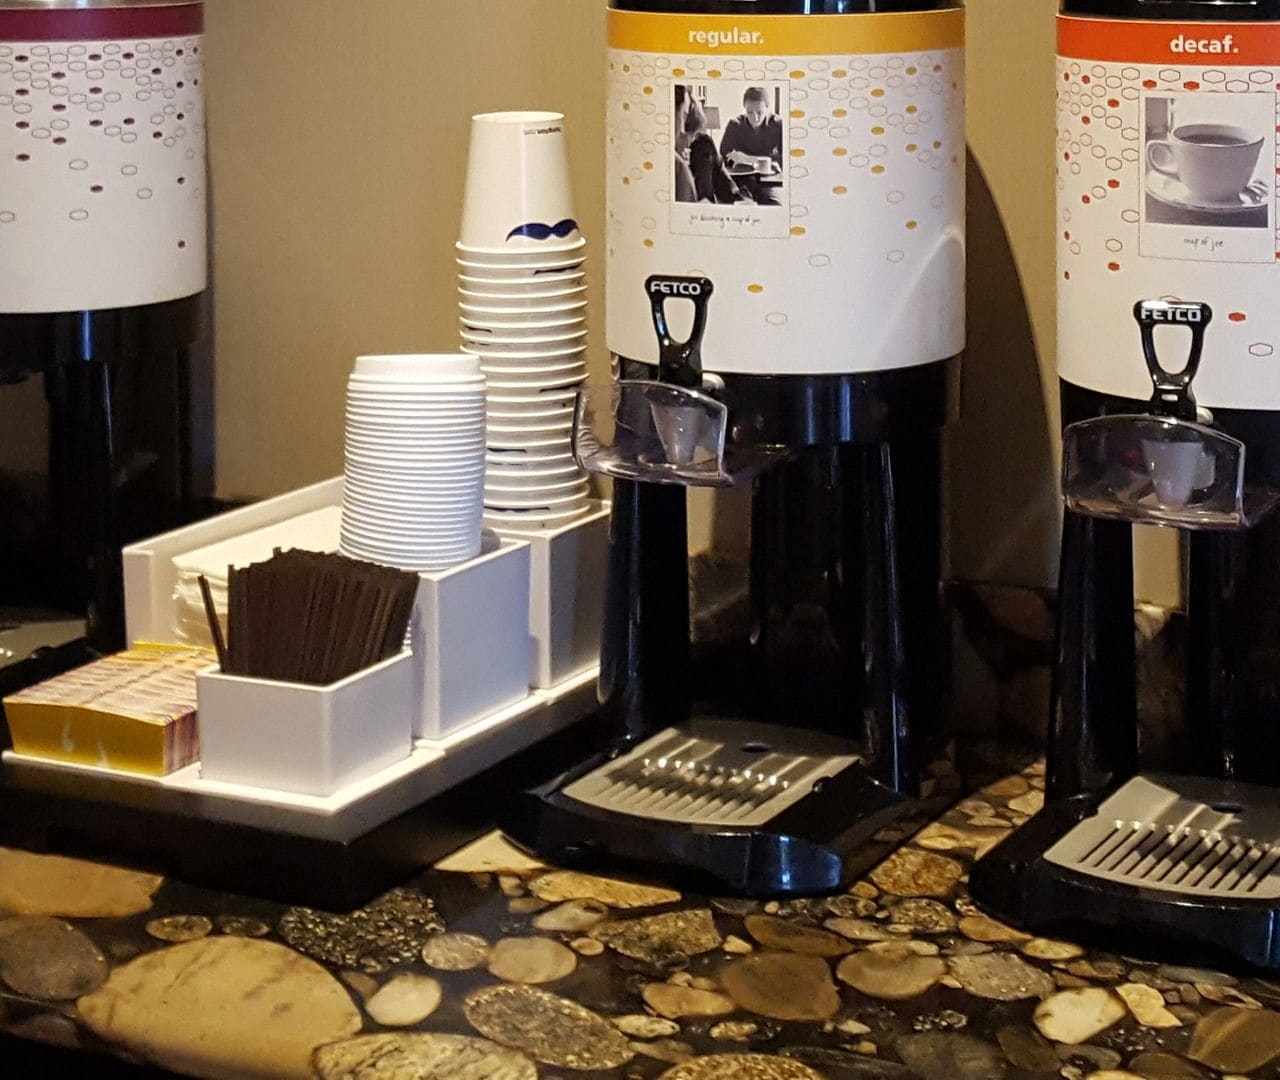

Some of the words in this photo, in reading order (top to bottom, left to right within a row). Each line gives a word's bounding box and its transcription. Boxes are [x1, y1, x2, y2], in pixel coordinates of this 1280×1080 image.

[688, 26, 765, 48] regular.
[1169, 34, 1239, 53] decaf.
[650, 281, 701, 295] FETCO
[1141, 307, 1201, 322] FETCO
